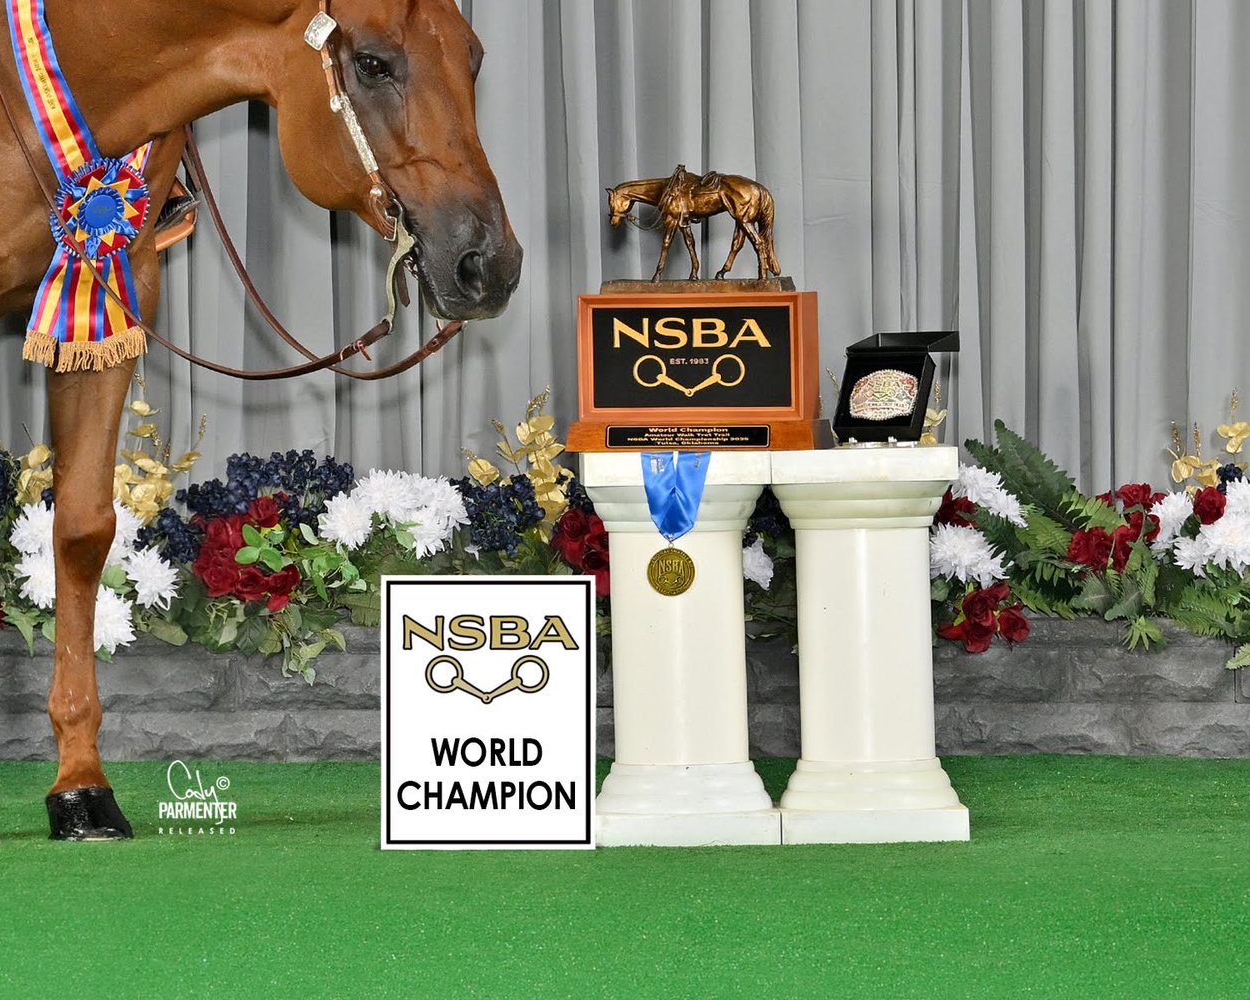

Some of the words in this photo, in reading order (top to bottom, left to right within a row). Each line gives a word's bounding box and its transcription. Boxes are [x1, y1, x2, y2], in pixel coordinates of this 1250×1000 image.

[612, 317, 772, 349] NSBA
[669, 357, 688, 366] EST.
[689, 357, 710, 366] 1983
[402, 614, 580, 652] NSBA
[431, 737, 543, 767] WORLD
[397, 780, 576, 811] CHAMPION
